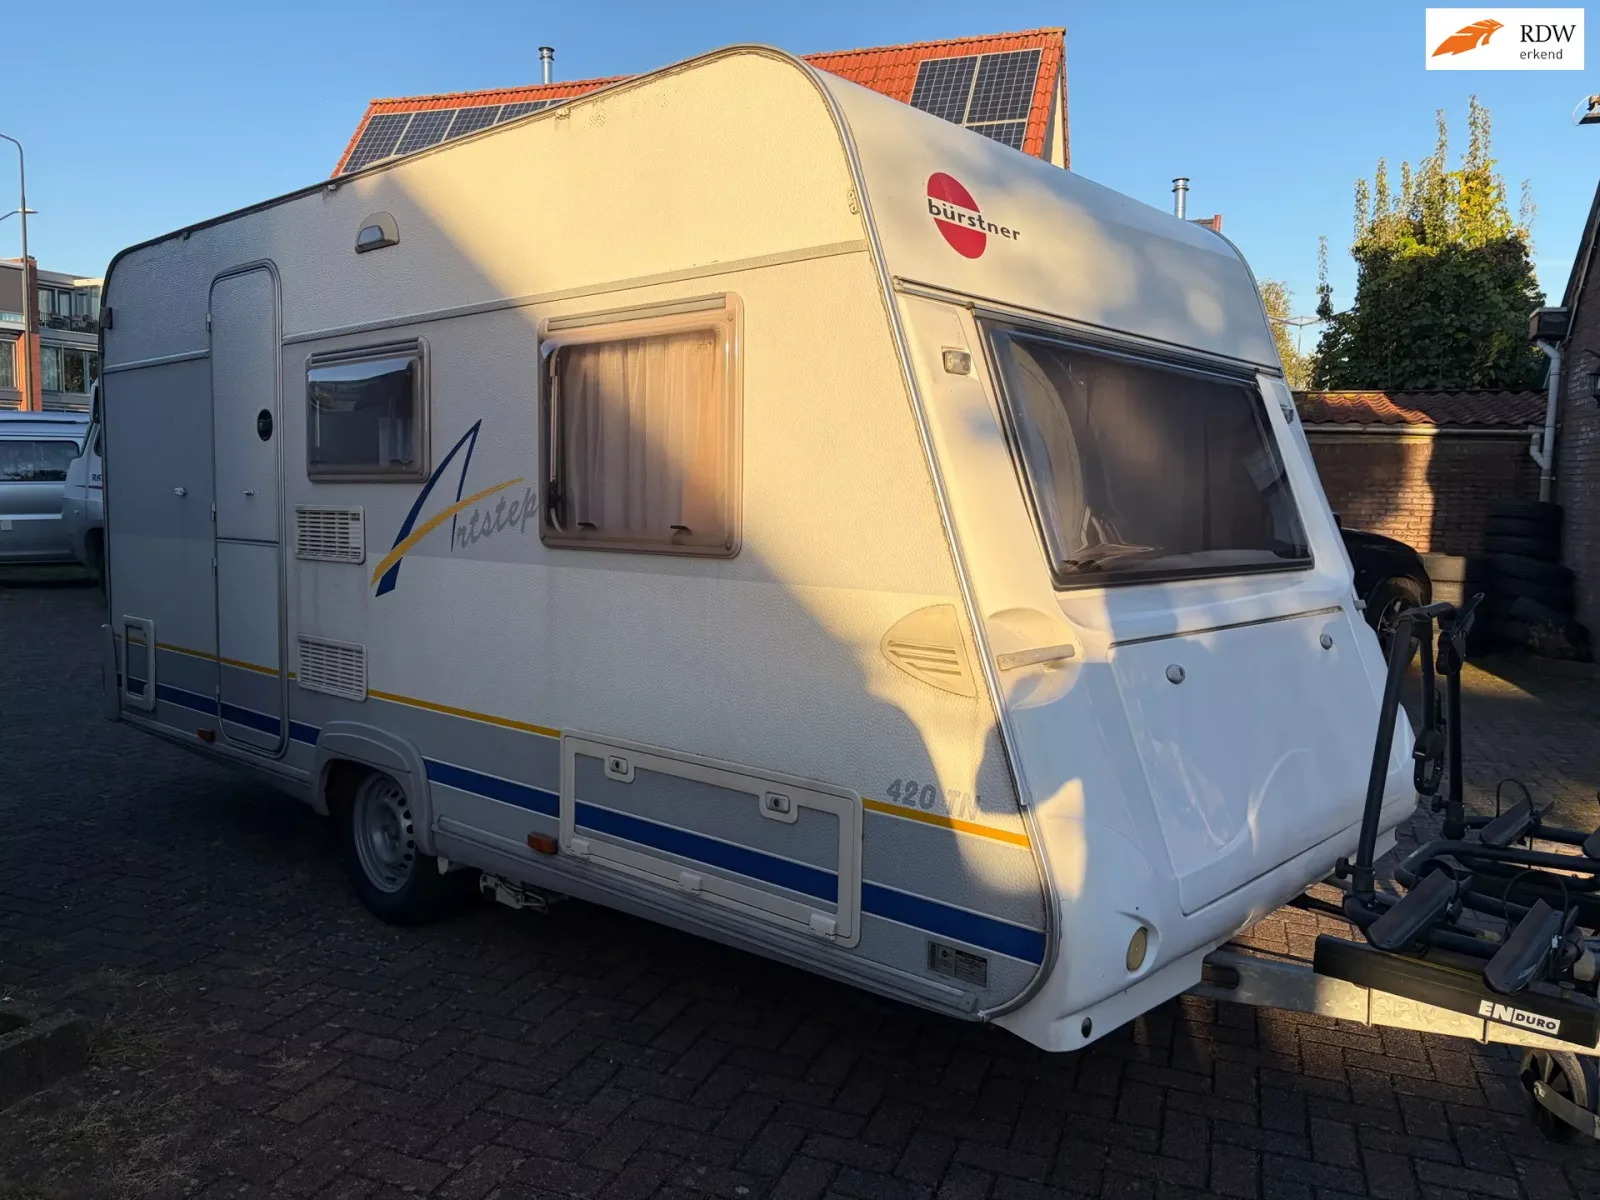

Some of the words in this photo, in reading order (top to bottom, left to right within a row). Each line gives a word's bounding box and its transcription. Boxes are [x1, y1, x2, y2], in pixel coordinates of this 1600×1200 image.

[927, 197, 1020, 241] bürstner
[886, 779, 936, 810] 420
[1478, 1000, 1560, 1035] ENDURO
